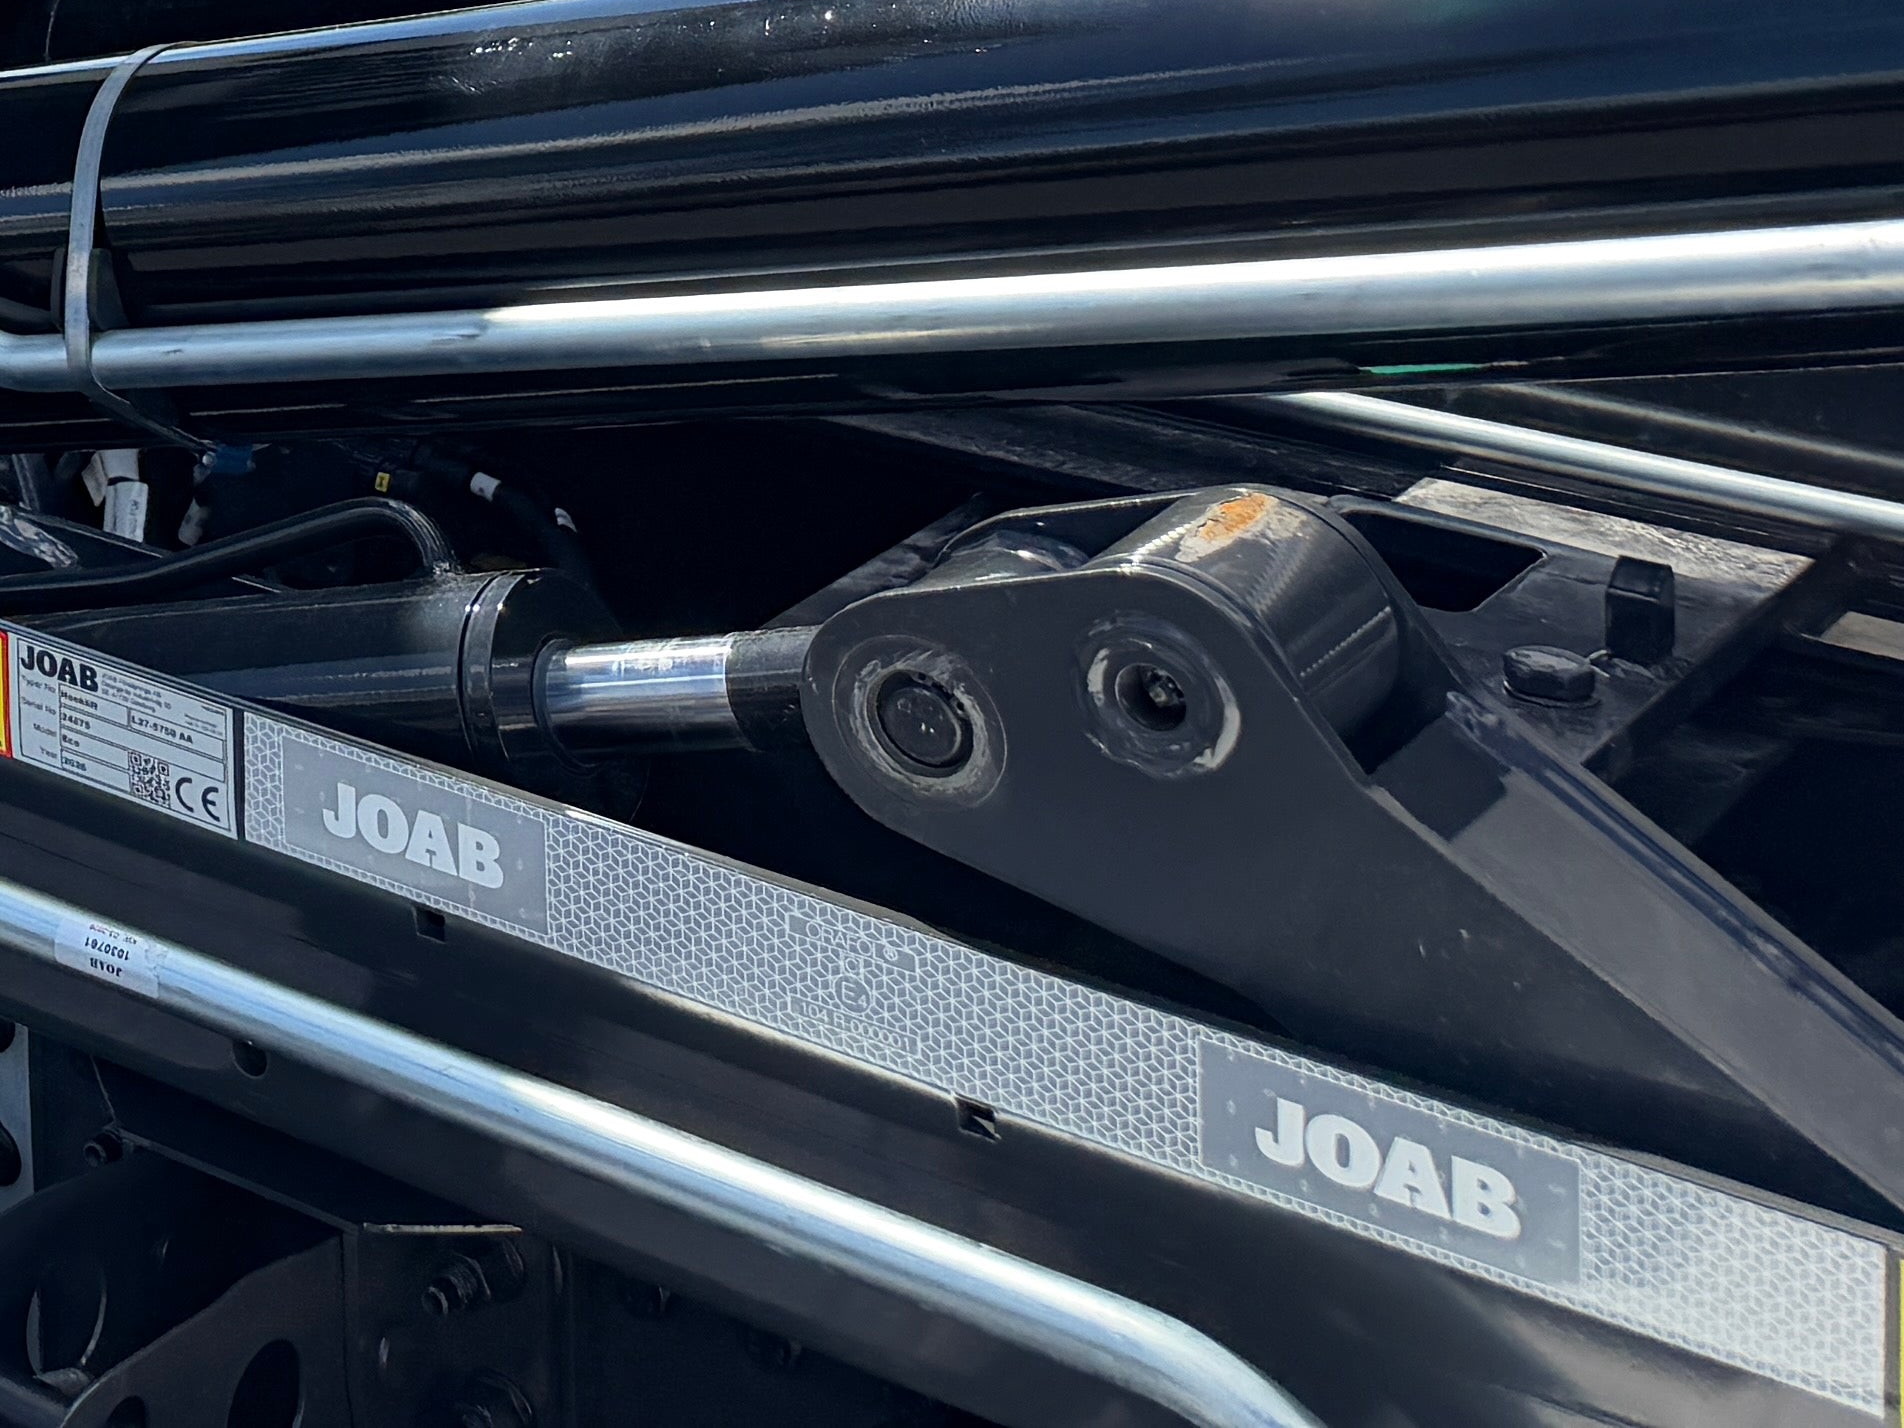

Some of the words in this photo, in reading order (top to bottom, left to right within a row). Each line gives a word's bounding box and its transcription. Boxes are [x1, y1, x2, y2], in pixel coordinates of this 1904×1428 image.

[21, 645, 98, 693] JOAB
[322, 782, 504, 889] JOAB
[90, 957, 123, 977] JOAB
[1254, 1097, 1522, 1239] JOAB
